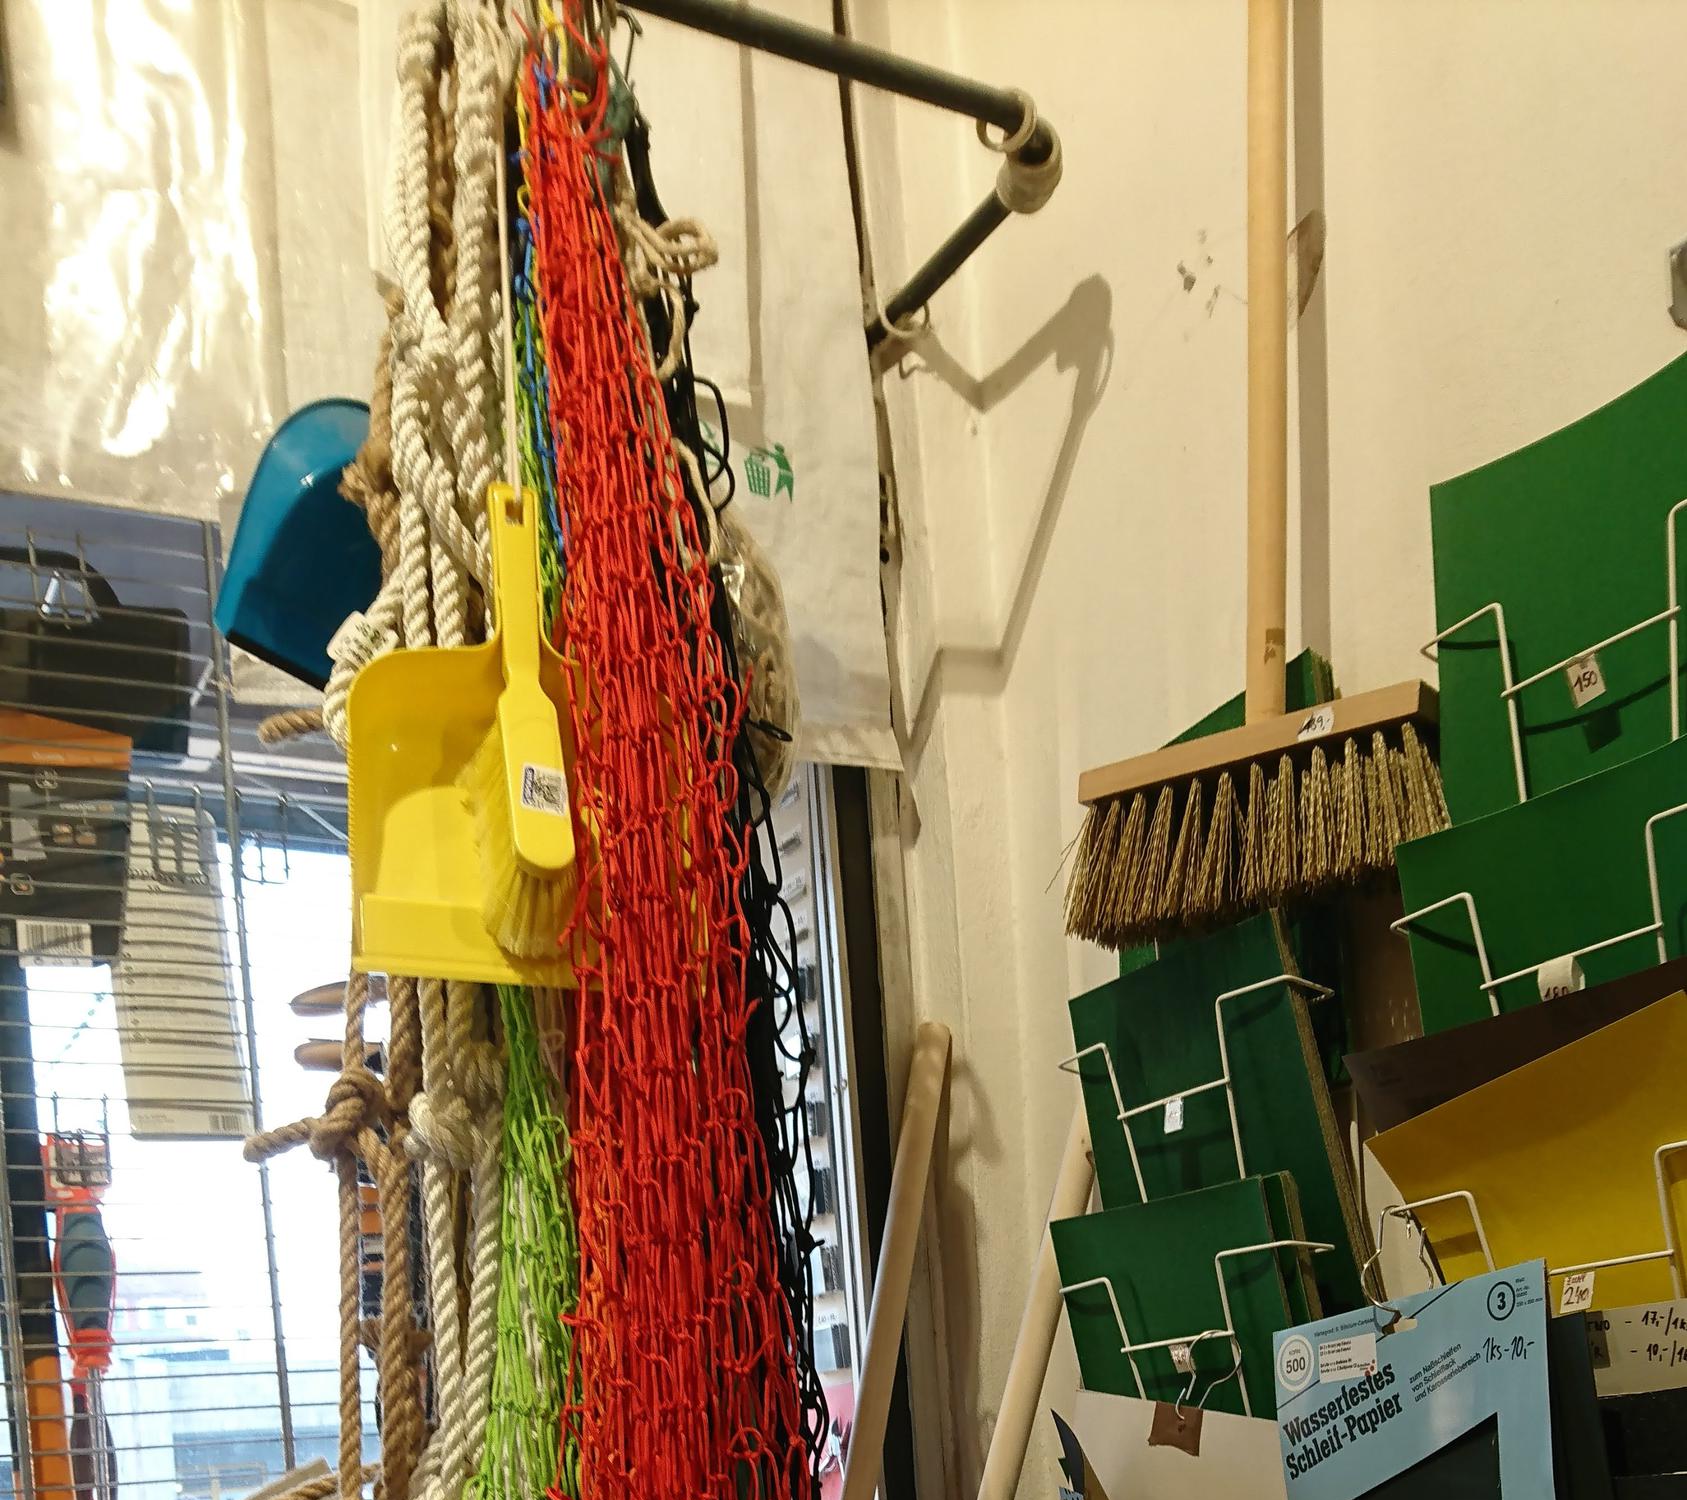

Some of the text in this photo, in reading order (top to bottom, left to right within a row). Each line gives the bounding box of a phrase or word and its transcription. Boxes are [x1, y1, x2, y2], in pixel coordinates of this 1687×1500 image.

[1573, 670, 1598, 692] 150
[1497, 1291, 1507, 1311] 3
[1286, 1357, 1306, 1374] 500
[1408, 1371, 1423, 1384] zum
[1411, 1382, 1424, 1393] von
[1414, 1390, 1427, 1402] und
[1283, 1363, 1396, 1447] Wasserfestes
[1286, 1392, 1403, 1480] Schleif-Papier
